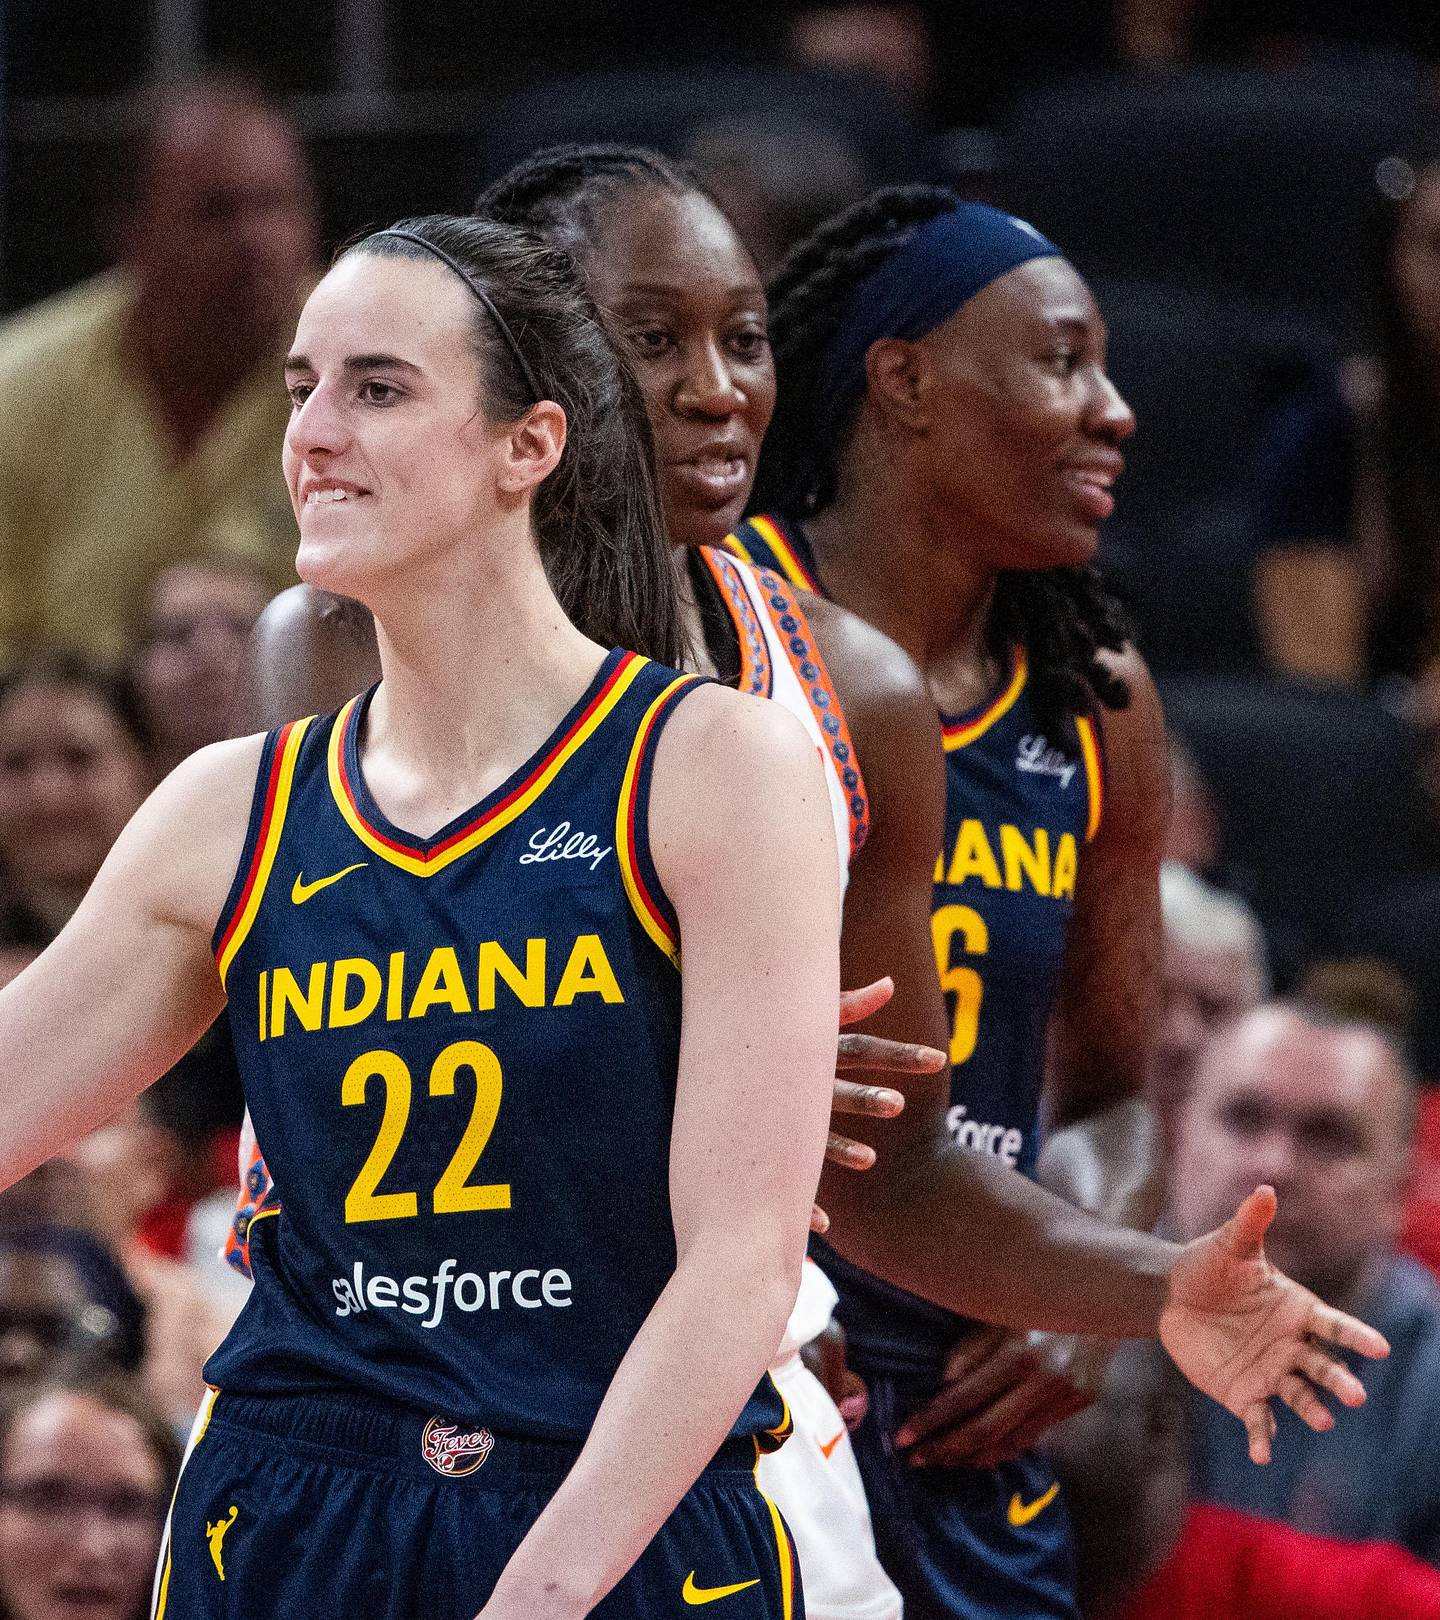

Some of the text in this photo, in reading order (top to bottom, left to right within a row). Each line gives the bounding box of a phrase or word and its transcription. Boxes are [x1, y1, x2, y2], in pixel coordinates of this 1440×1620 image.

[1015, 734, 1076, 790] Lilly
[519, 821, 613, 871] Lilly
[259, 934, 625, 1042] INDIANA
[930, 903, 990, 1066] 6
[341, 1040, 512, 1224] 22
[332, 1259, 573, 1329] salesforce
[424, 1425, 495, 1459] Fever
